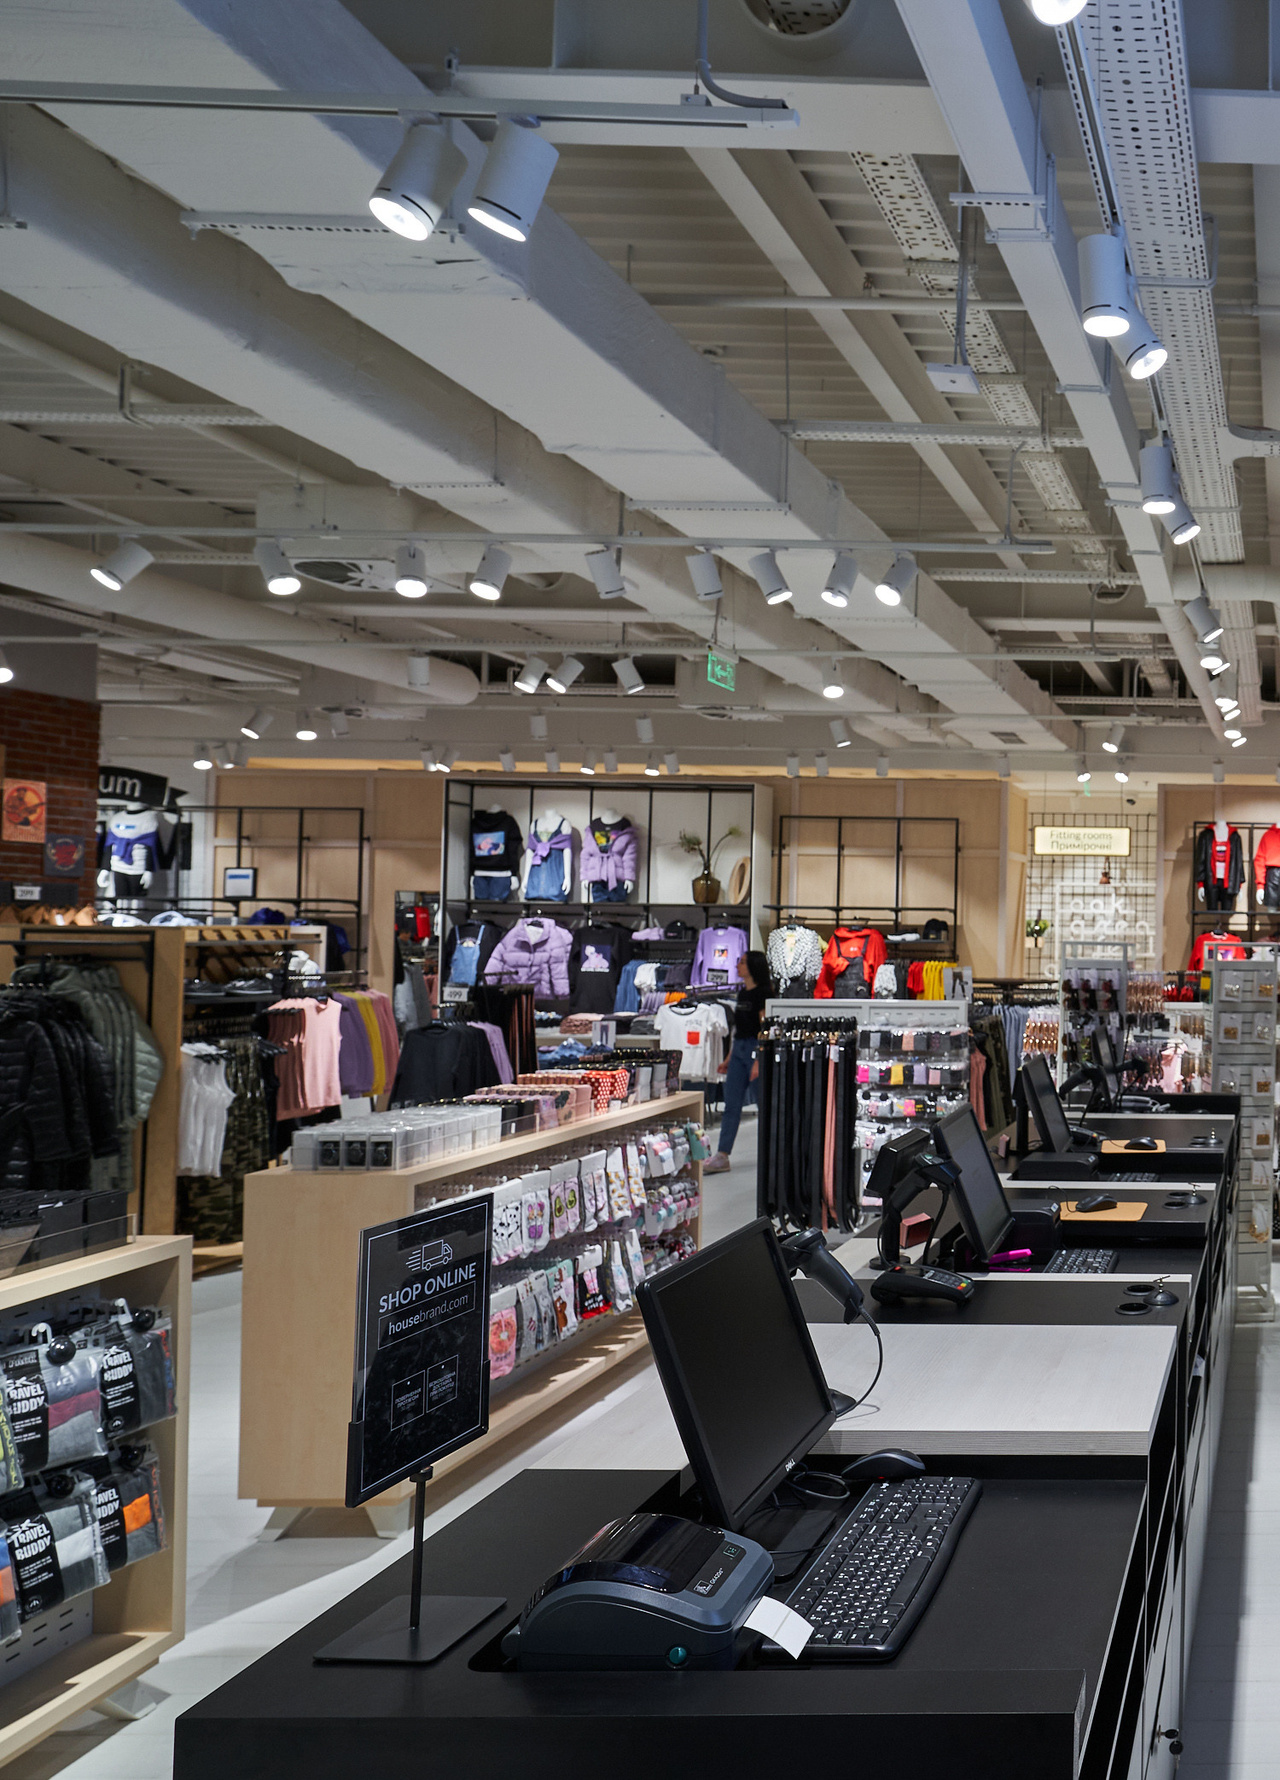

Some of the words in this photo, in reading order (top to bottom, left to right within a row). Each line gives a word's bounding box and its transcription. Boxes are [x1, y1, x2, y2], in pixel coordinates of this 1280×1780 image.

[1050, 830, 1082, 841] Fitting
[1083, 831, 1113, 840] rooms
[1051, 840, 1112, 851] Примірочні
[379, 1283, 422, 1313] SHOP
[424, 1262, 476, 1295] ONLINE
[388, 1294, 468, 1335] housebrand.com
[101, 1351, 133, 1370] TRAVEL
[104, 1363, 134, 1382] BUDDY
[12, 1523, 50, 1548] TRAVEL
[15, 1535, 51, 1561] BUDDY
